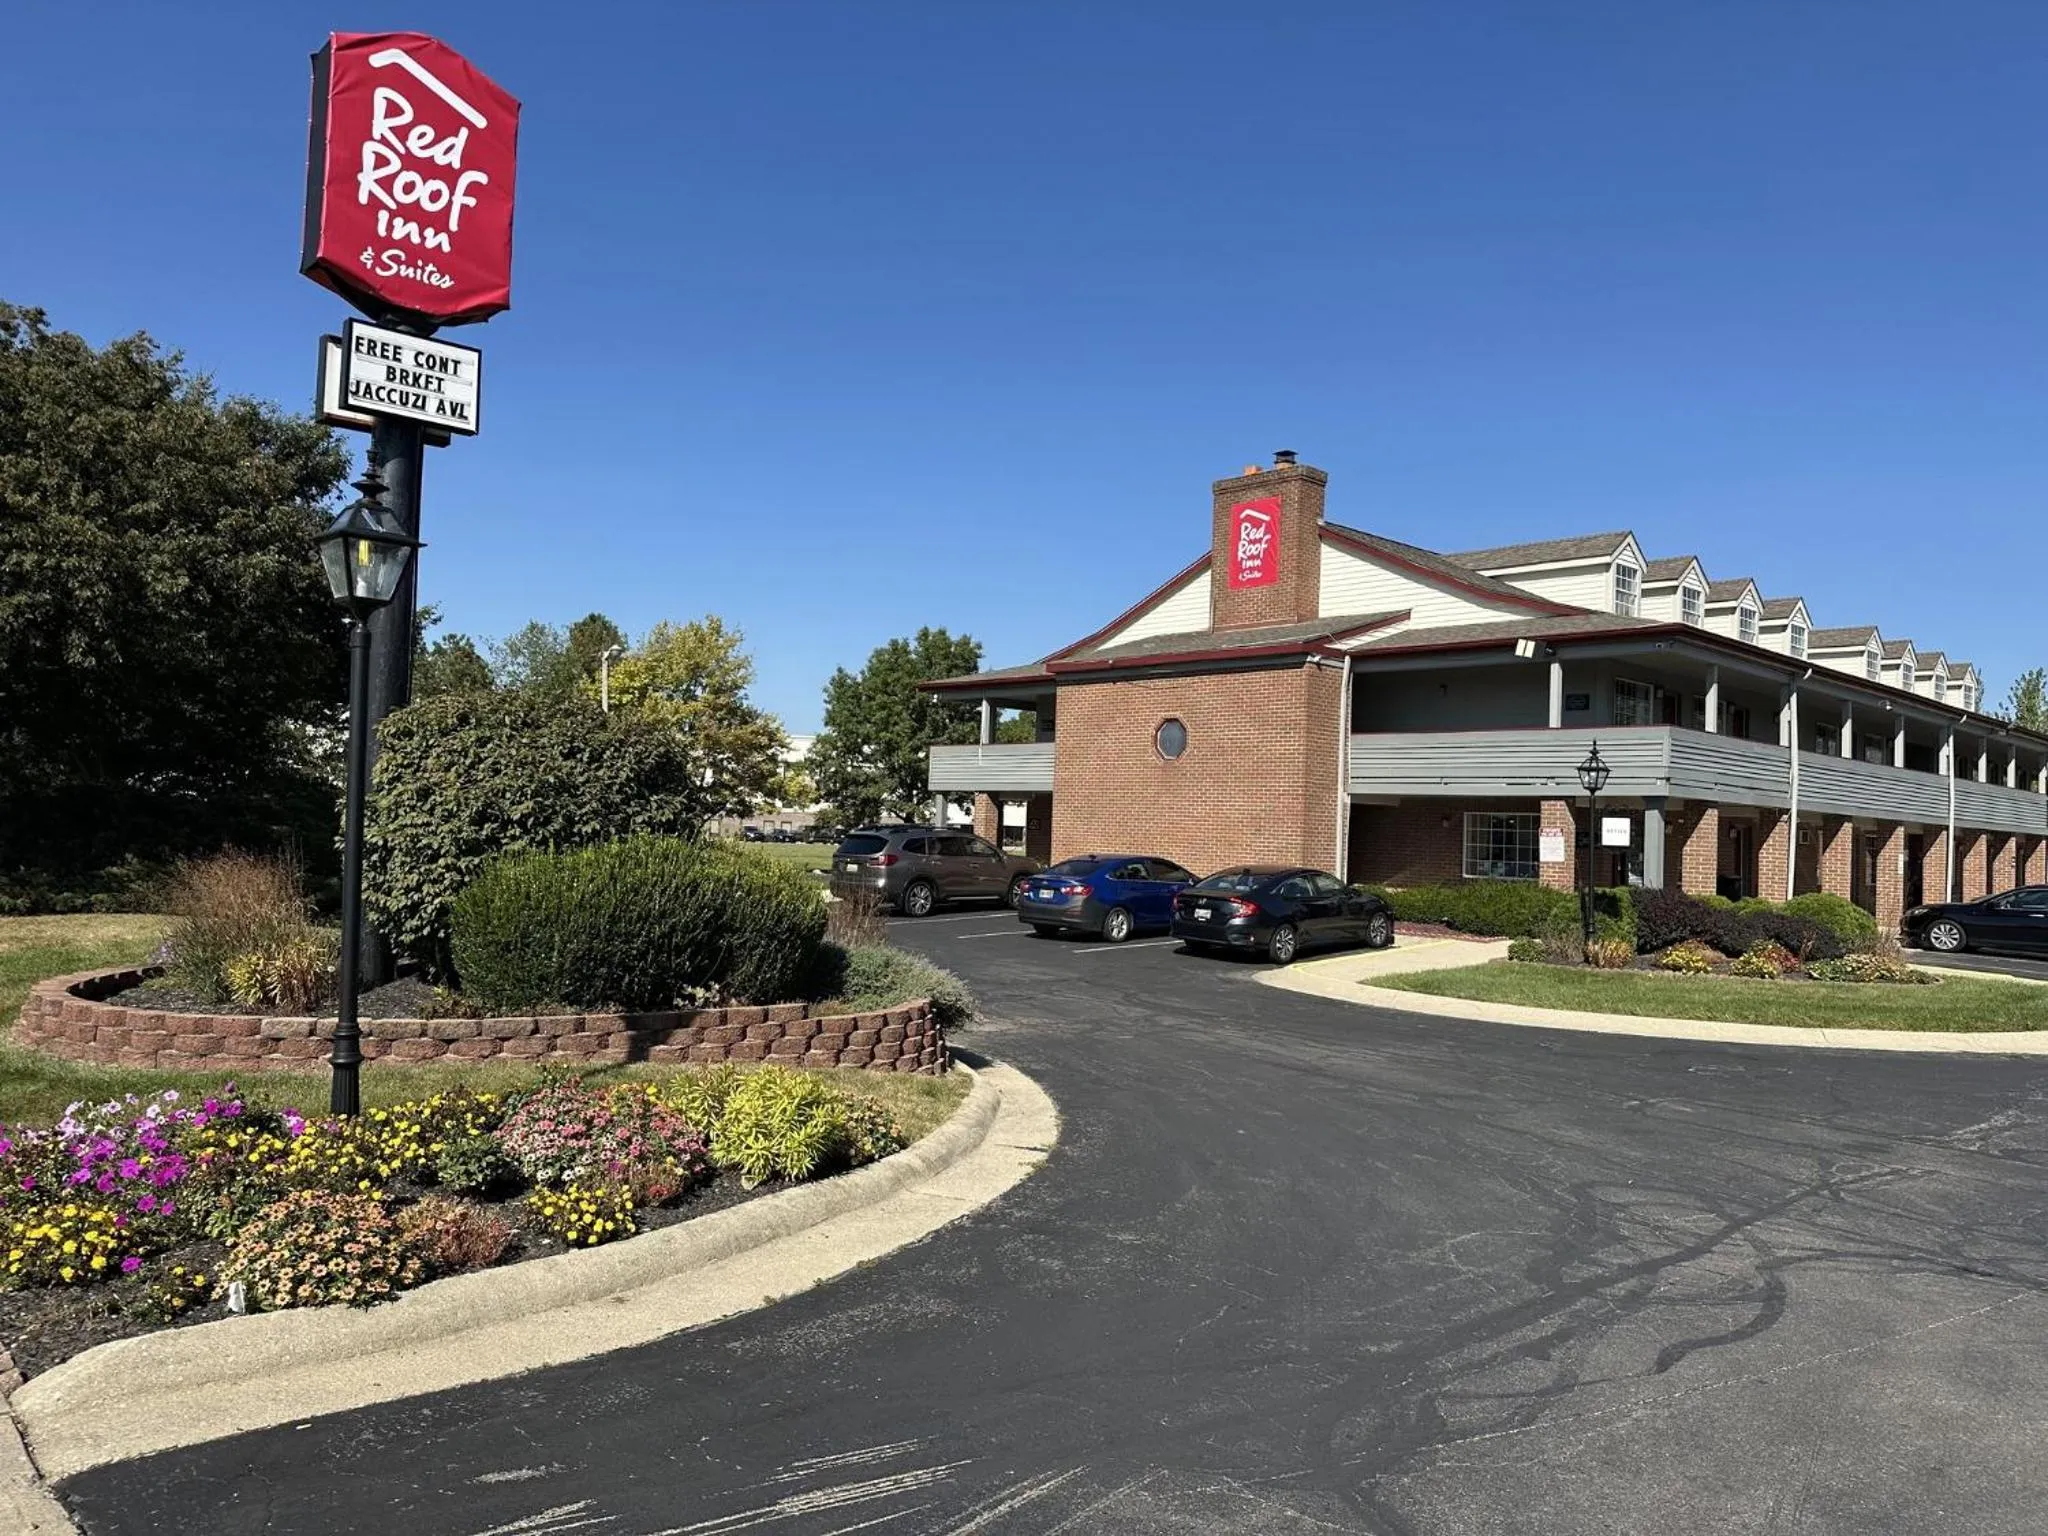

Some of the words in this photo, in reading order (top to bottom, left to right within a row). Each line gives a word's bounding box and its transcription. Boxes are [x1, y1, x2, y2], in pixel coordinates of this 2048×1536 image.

[372, 87, 468, 170] Red
[357, 141, 488, 232] Roof
[377, 209, 451, 253] Inn
[359, 246, 375, 268] &
[375, 249, 455, 288] Suites
[354, 335, 402, 362] FREE
[414, 351, 460, 376] CONT
[350, 379, 427, 411] JACCUZI
[436, 399, 468, 420] AVL
[385, 365, 445, 394] BRKFT
[1237, 534, 1272, 562] Roof
[1240, 522, 1266, 542] Red
